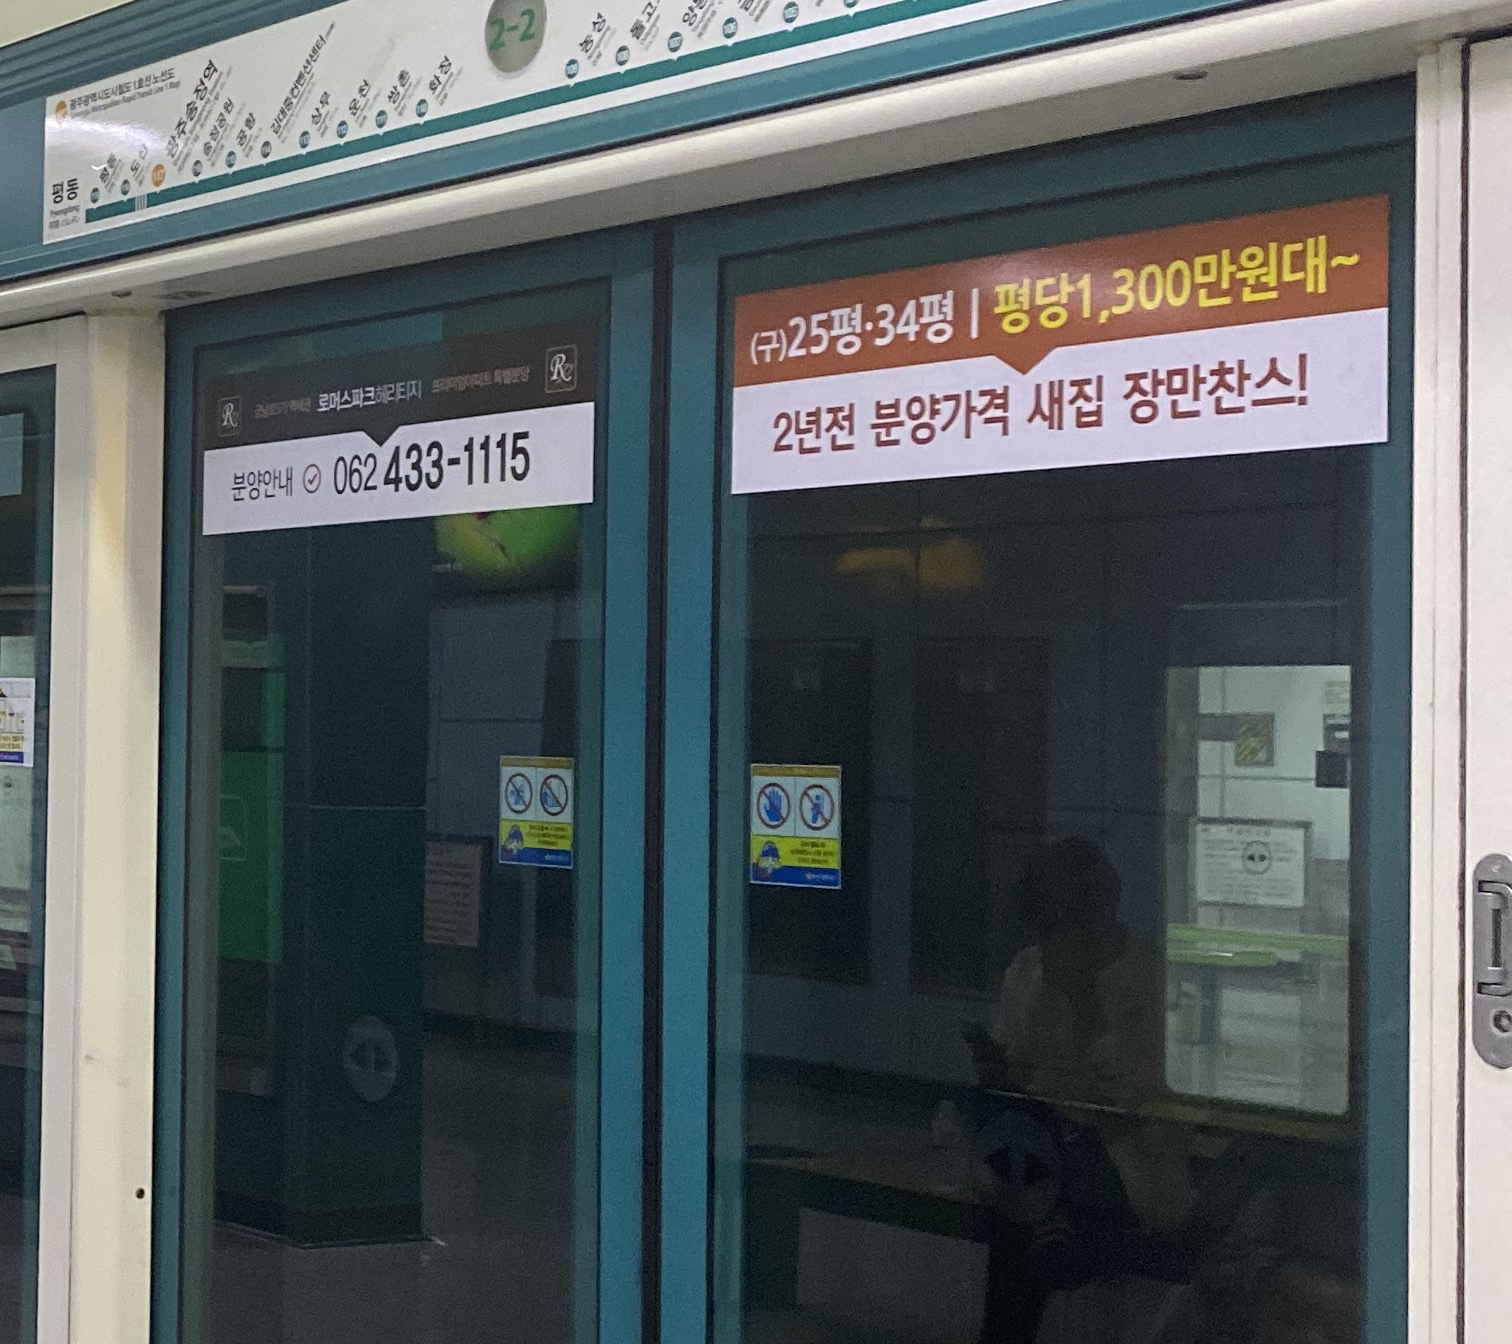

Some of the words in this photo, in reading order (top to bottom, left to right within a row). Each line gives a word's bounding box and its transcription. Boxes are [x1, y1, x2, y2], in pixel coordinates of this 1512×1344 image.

[489, 9, 535, 52] 2-2
[167, 59, 217, 158] 광주송정역
[993, 234, 1361, 336] 평당1,300만원대~
[772, 401, 857, 456] 2년전
[870, 385, 1011, 447] 분양가격
[1027, 374, 1104, 431] 새집
[1122, 353, 1310, 426] 장만찬스!
[231, 467, 294, 503] 분양안내
[333, 453, 378, 495] 062
[383, 431, 531, 493] 433-1115
